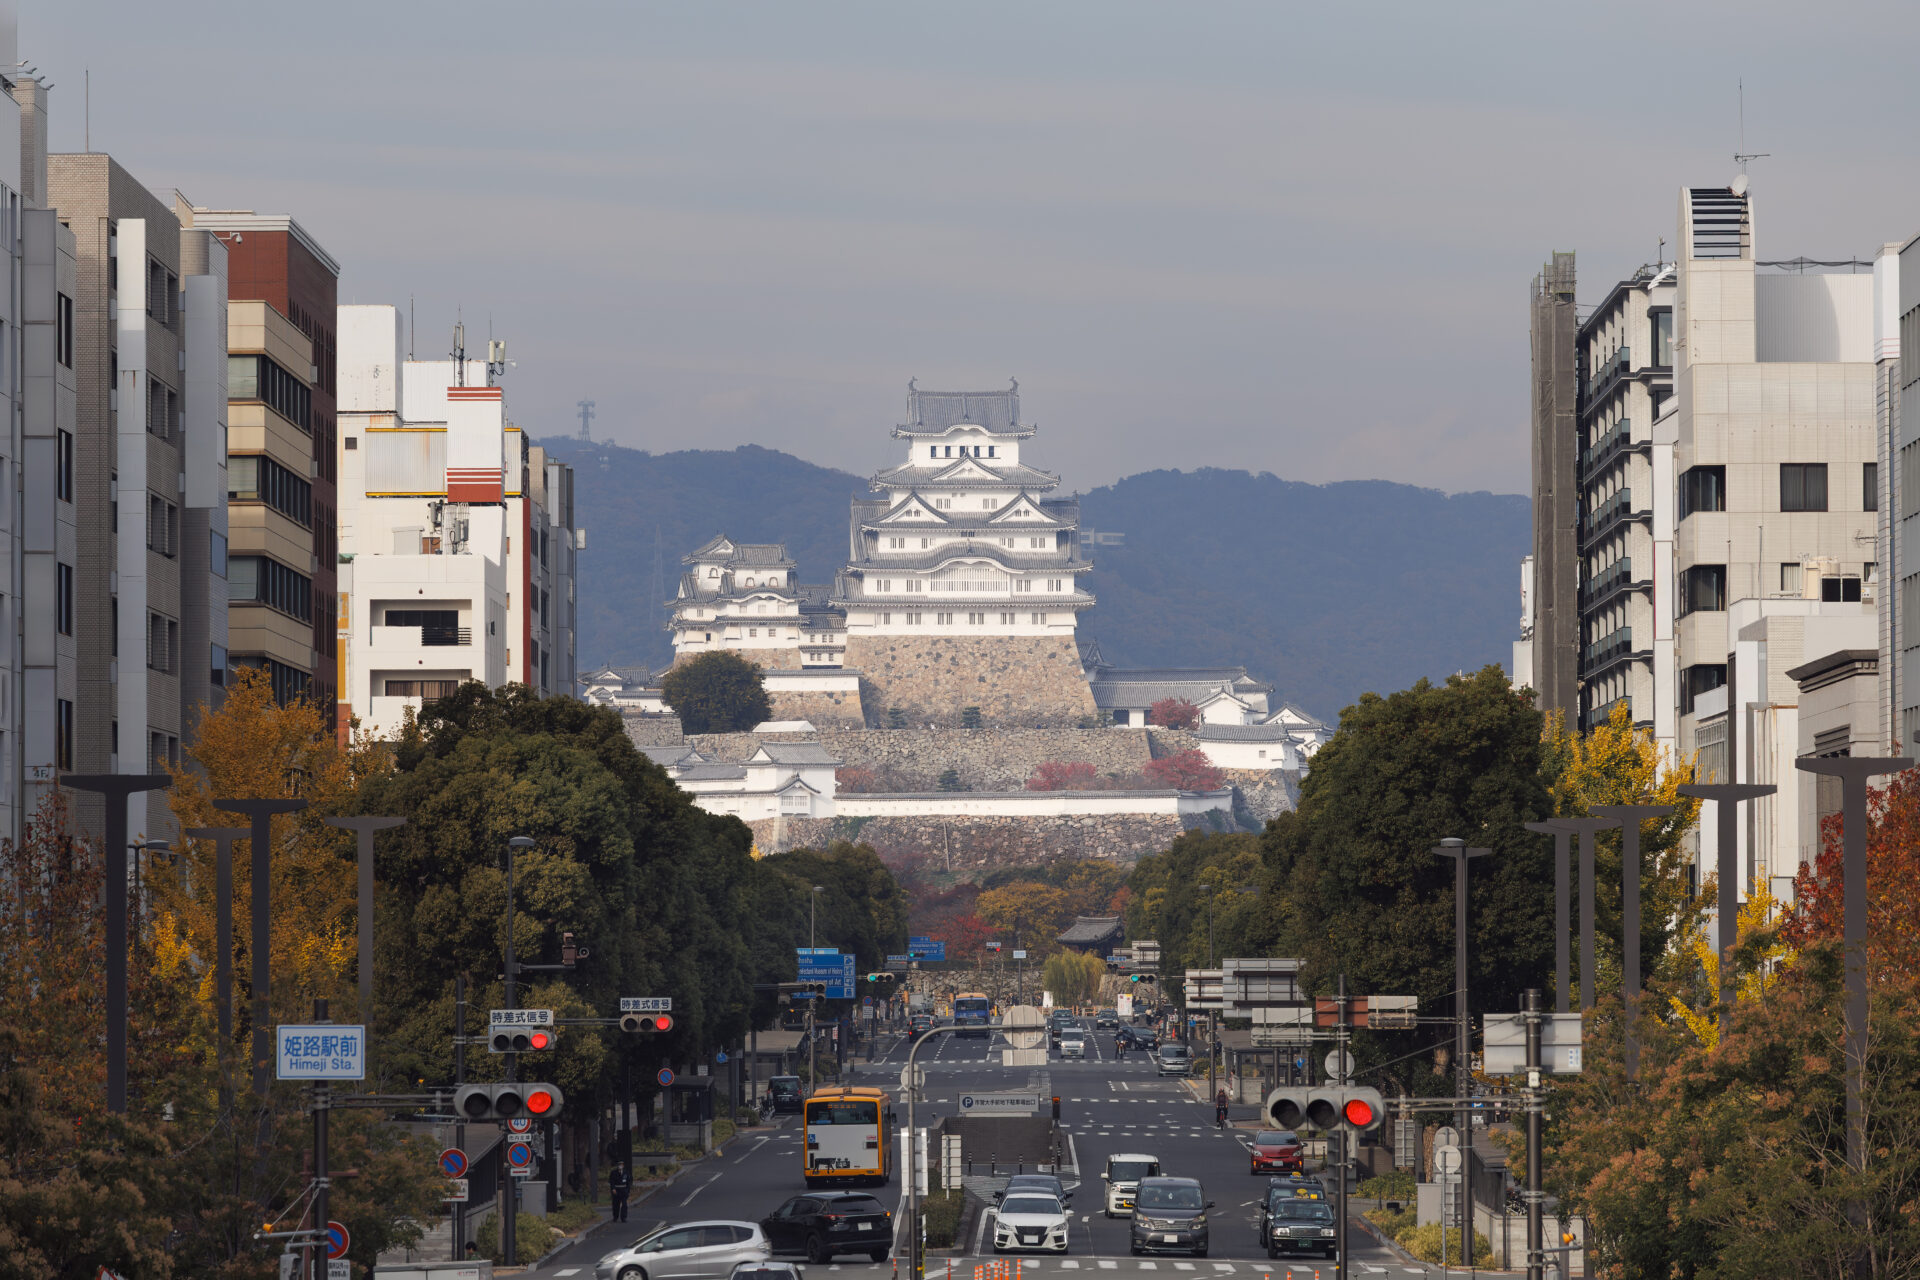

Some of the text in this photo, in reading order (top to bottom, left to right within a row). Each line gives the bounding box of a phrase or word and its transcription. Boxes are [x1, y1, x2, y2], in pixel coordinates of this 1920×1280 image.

[621, 999, 670, 1010] 時差式信号
[492, 1011, 549, 1023] 時差式信号
[284, 1035, 357, 1057] 姫路駅前
[289, 1058, 355, 1072] Himeji Sta.
[513, 1118, 526, 1127] 40
